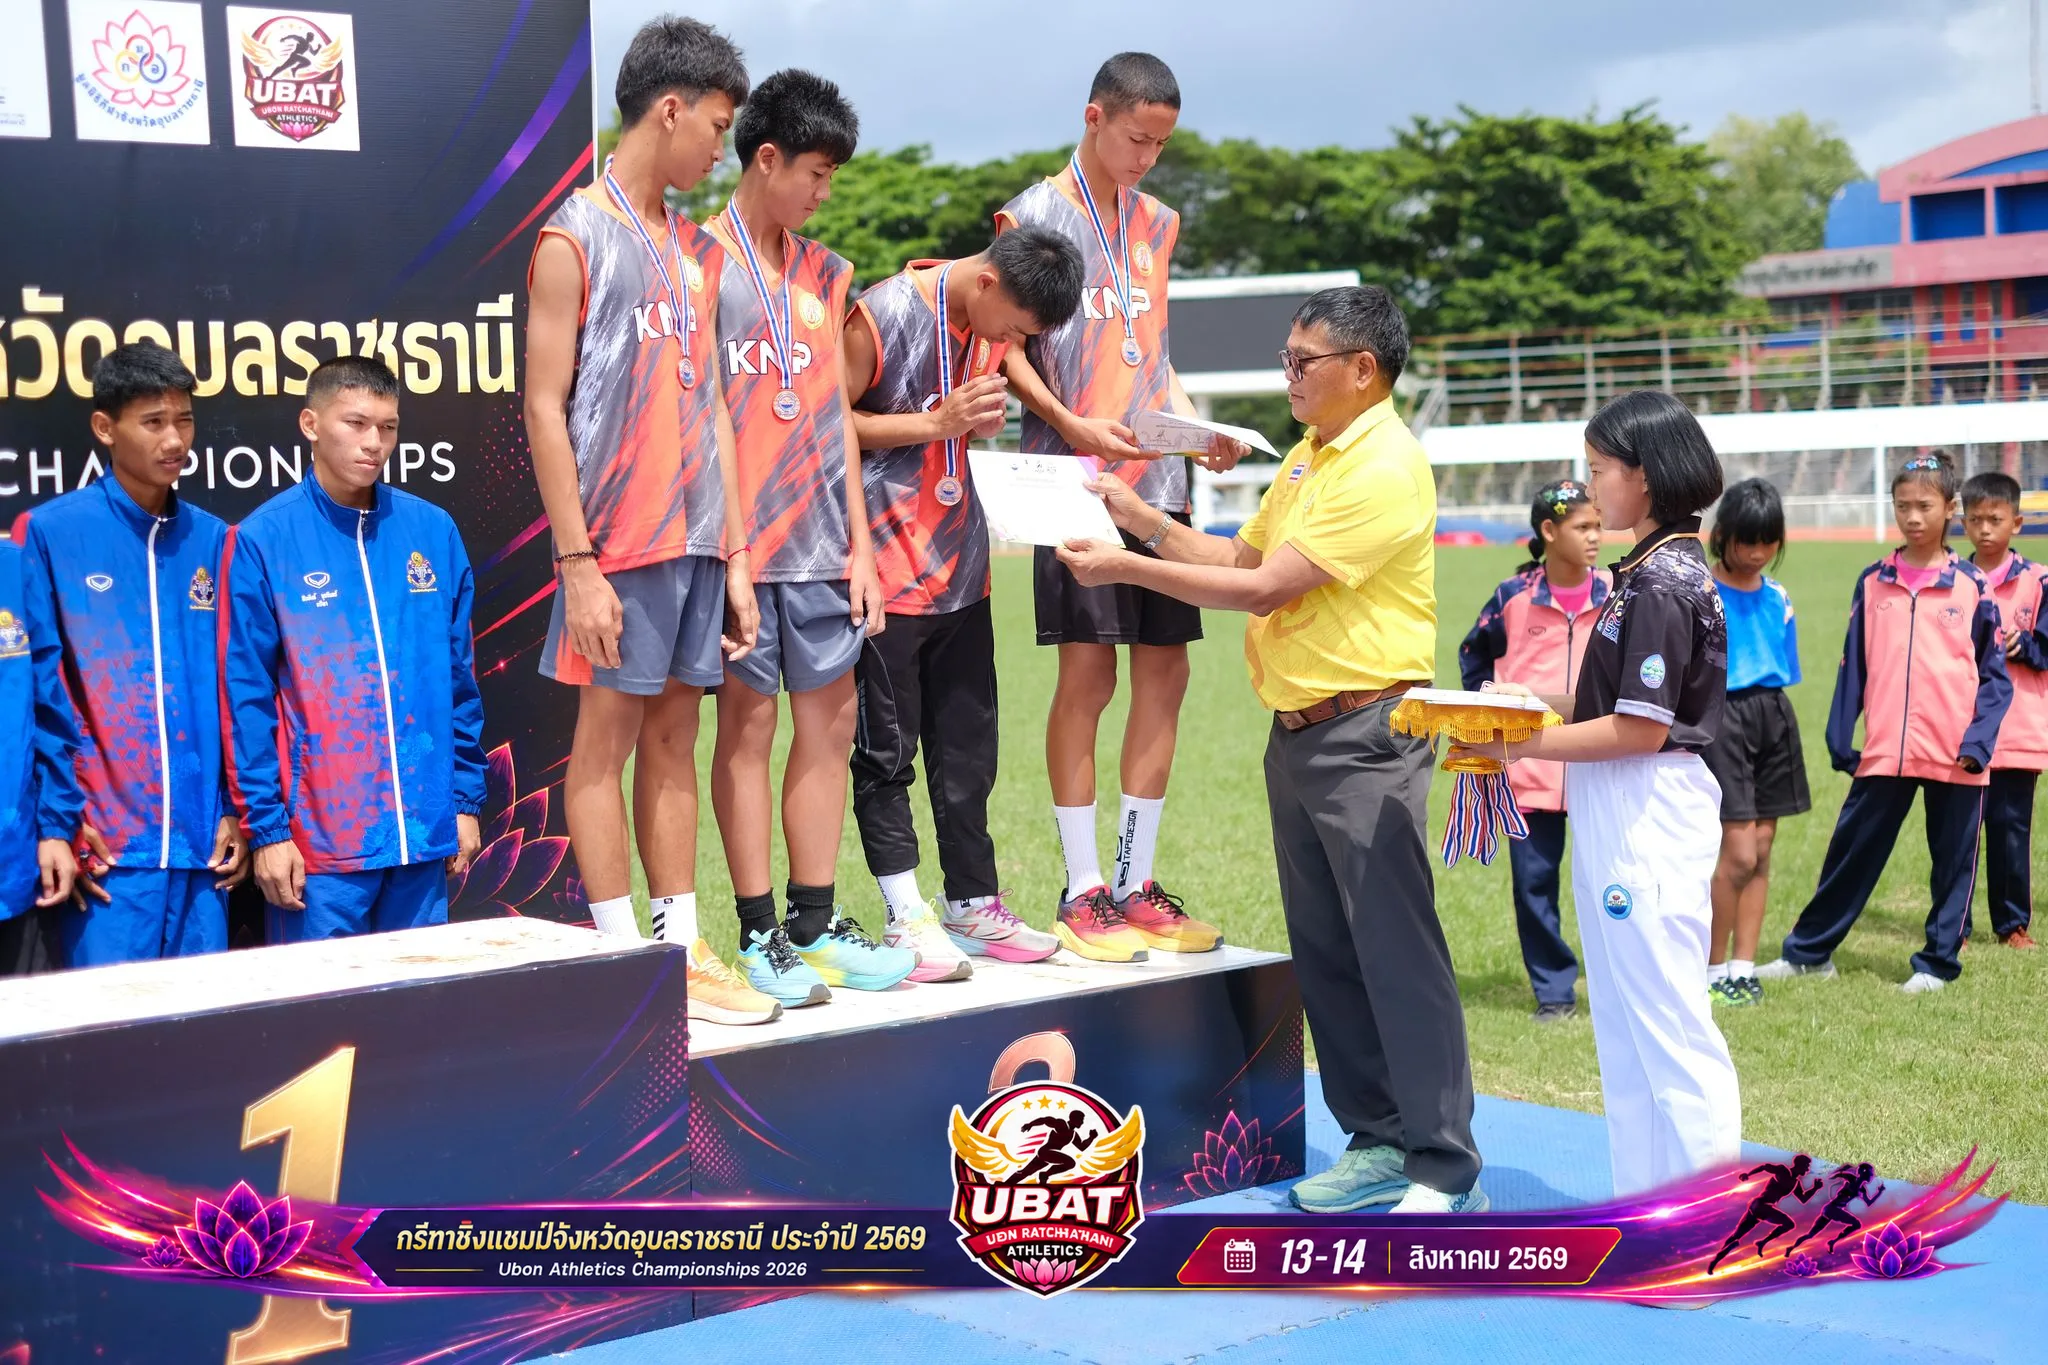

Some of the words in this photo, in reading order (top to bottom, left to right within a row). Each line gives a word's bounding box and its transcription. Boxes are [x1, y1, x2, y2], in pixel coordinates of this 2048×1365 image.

[253, 78, 338, 106] UBAT
[261, 105, 283, 115] UBON
[276, 114, 318, 123] ATHLETICS
[1081, 286, 1151, 319] KNP
[727, 339, 812, 375] KNP
[1123, 809, 1138, 861] TAPEDESIGN
